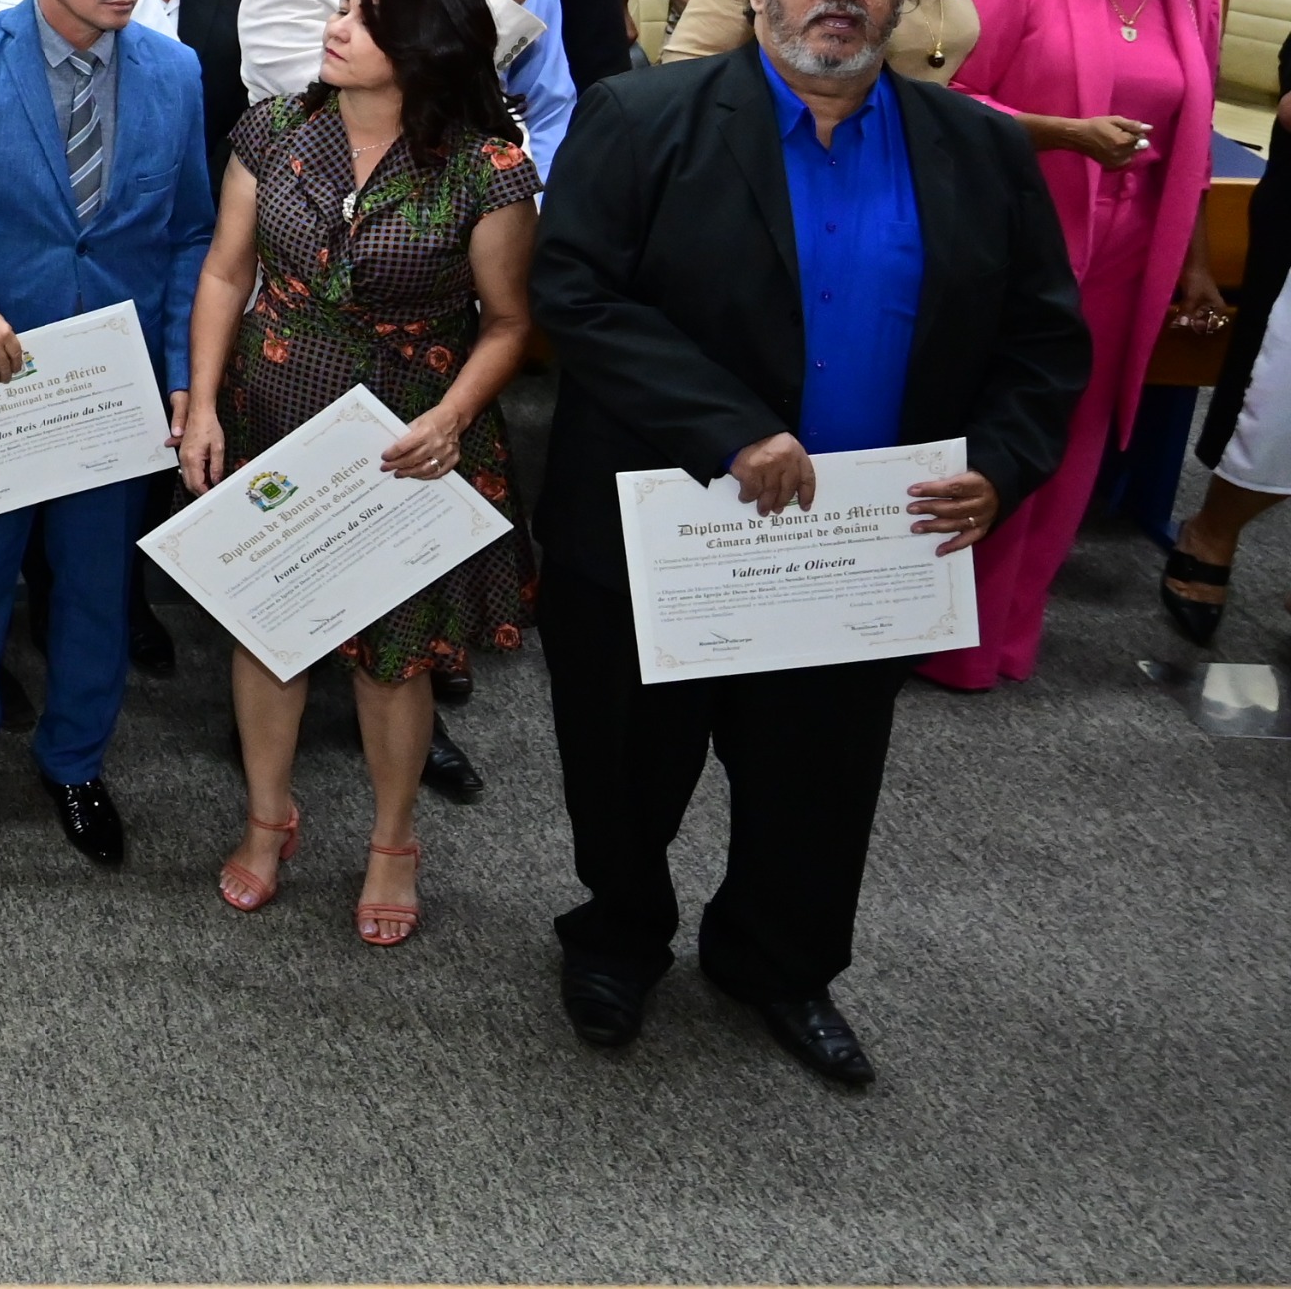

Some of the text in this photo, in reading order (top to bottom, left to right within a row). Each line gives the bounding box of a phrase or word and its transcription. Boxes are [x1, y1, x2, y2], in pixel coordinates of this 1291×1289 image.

[3, 381, 44, 398] Honra
[47, 377, 60, 386] ao
[64, 365, 106, 383] Mérito
[55, 381, 92, 396] Goiânia
[15, 422, 37, 434] Reis
[39, 411, 79, 428] Antônio
[82, 406, 94, 415] da
[97, 400, 122, 412] Silva
[217, 457, 369, 565] Diploma de Honra ao Mérito
[248, 478, 365, 562] Câmara Municipal de Goiânia
[677, 503, 900, 537] Diploma de Honra ao Mérito
[273, 503, 384, 583] Ivone Gonçalves da Silva
[705, 522, 879, 549] Câmara Municipal de Goiânia
[732, 556, 855, 578] Valtenir de Oliveira
